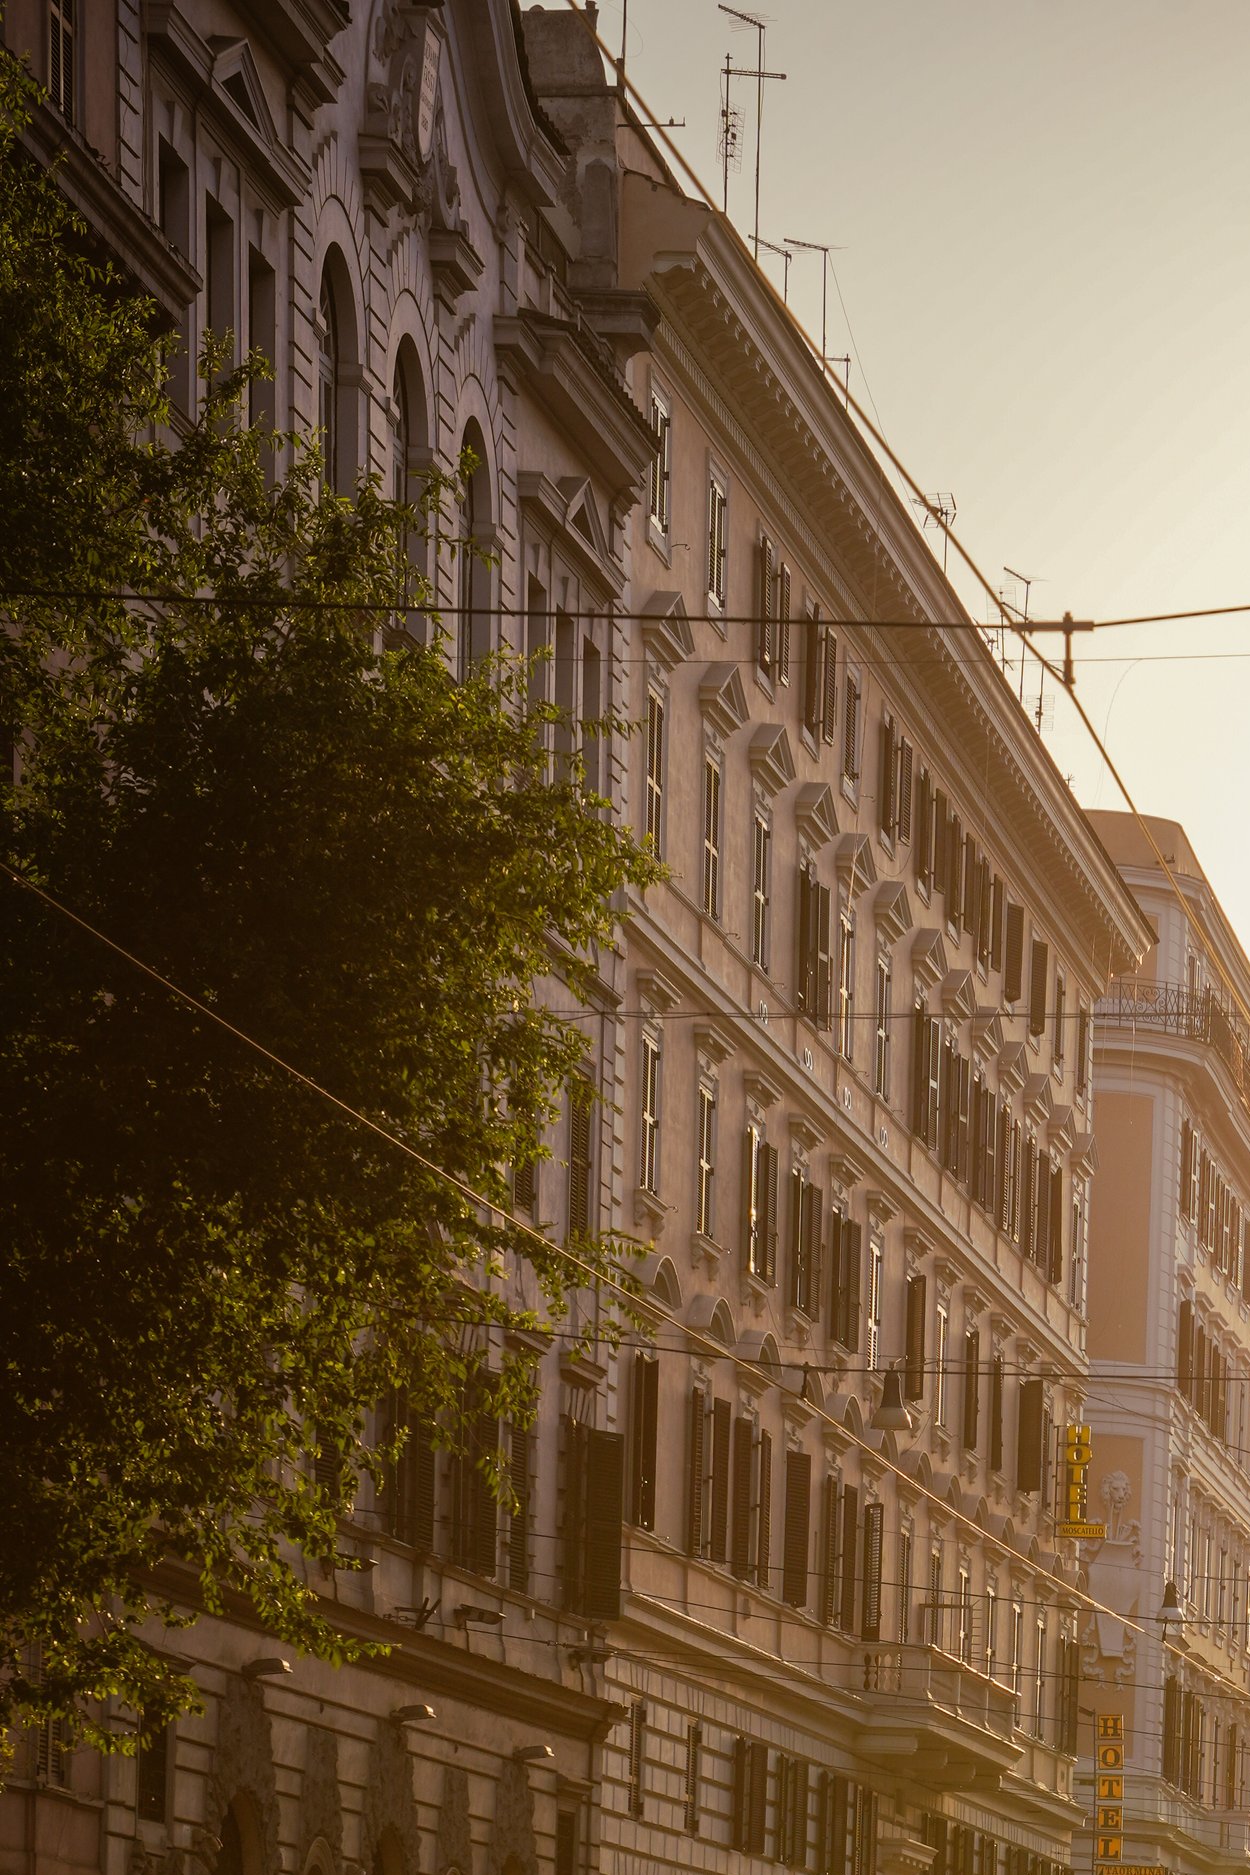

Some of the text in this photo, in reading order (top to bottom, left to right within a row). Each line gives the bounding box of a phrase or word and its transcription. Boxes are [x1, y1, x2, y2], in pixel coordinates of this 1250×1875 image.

[1066, 1425, 1092, 1523] HOTEL
[1062, 1527, 1104, 1536] MOSCATELLO
[1100, 1717, 1121, 1859] HOTEL
[1105, 1866, 1161, 1875] TAORMINA
